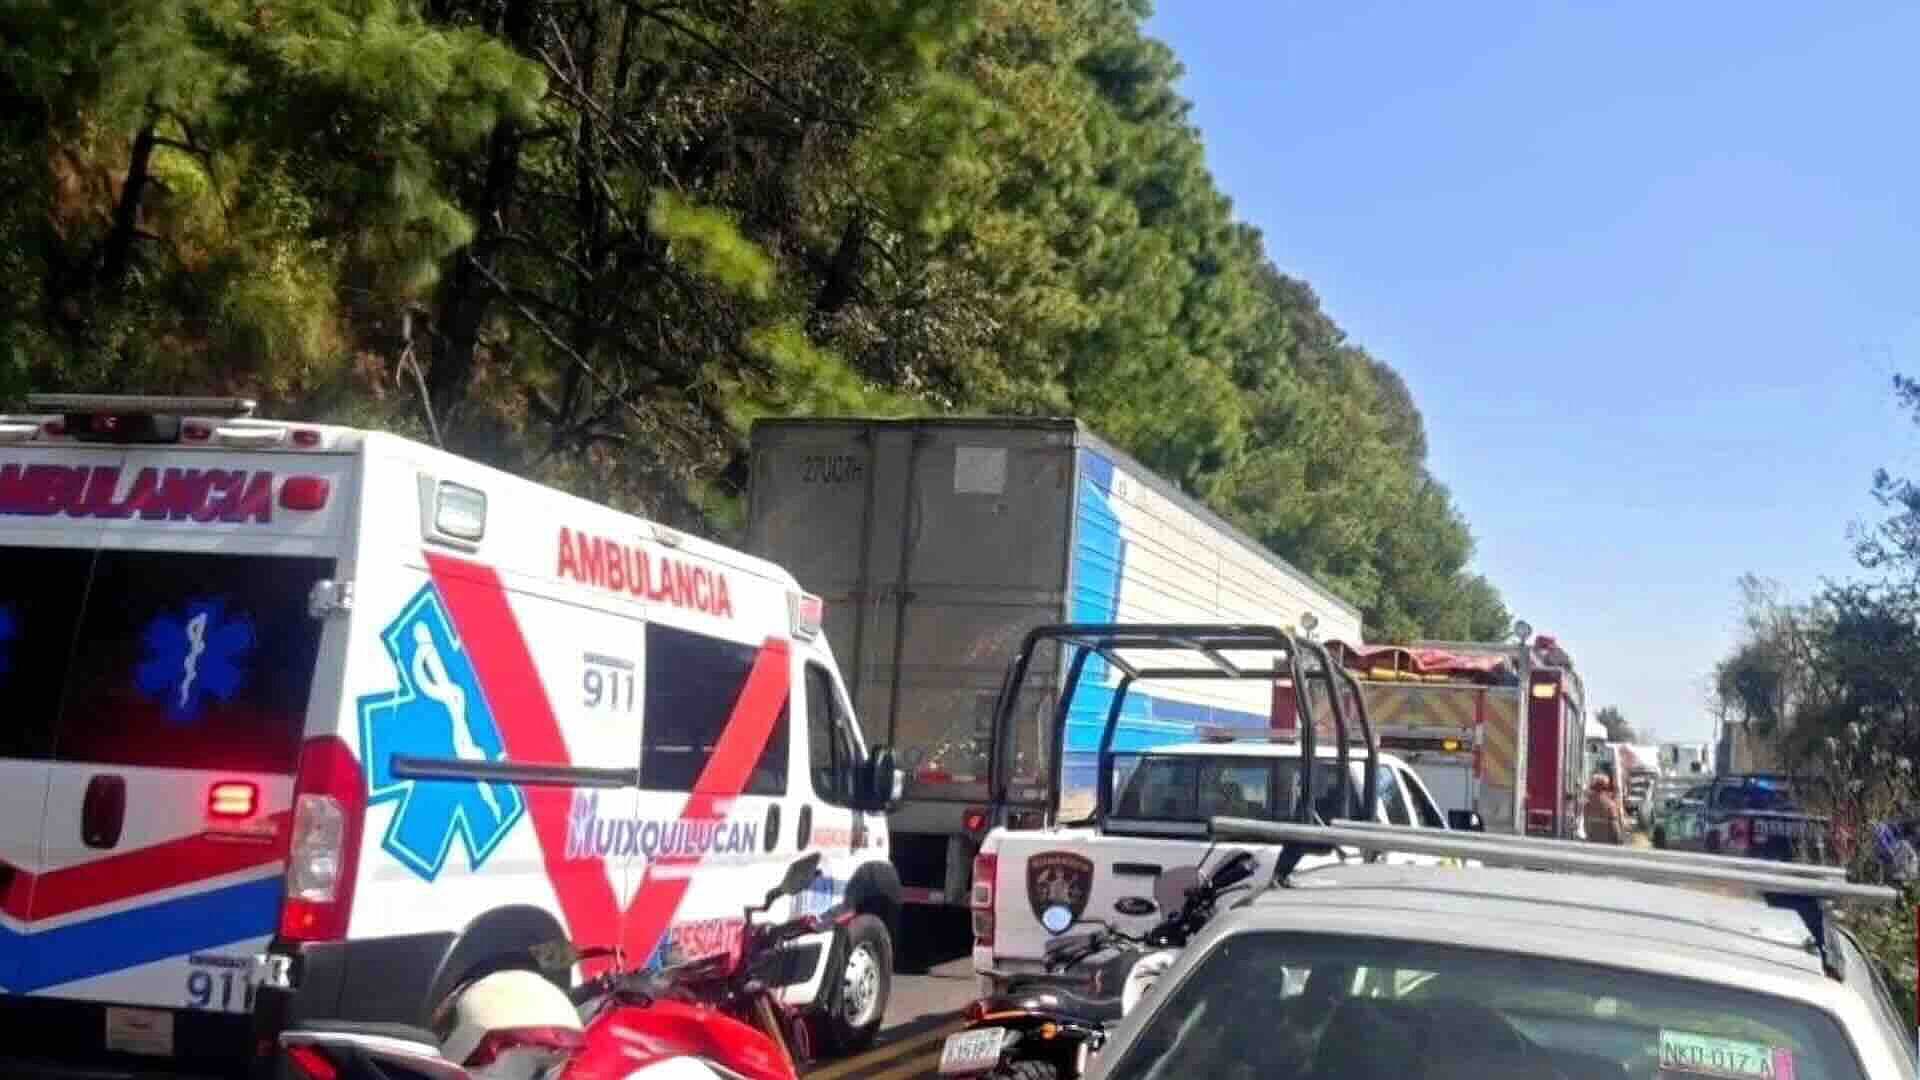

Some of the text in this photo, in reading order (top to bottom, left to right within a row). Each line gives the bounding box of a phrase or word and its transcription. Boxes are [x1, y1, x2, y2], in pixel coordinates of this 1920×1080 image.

[557, 526, 733, 619] AMBULANCIA
[583, 671, 634, 712] 911
[187, 971, 254, 1010] 911
